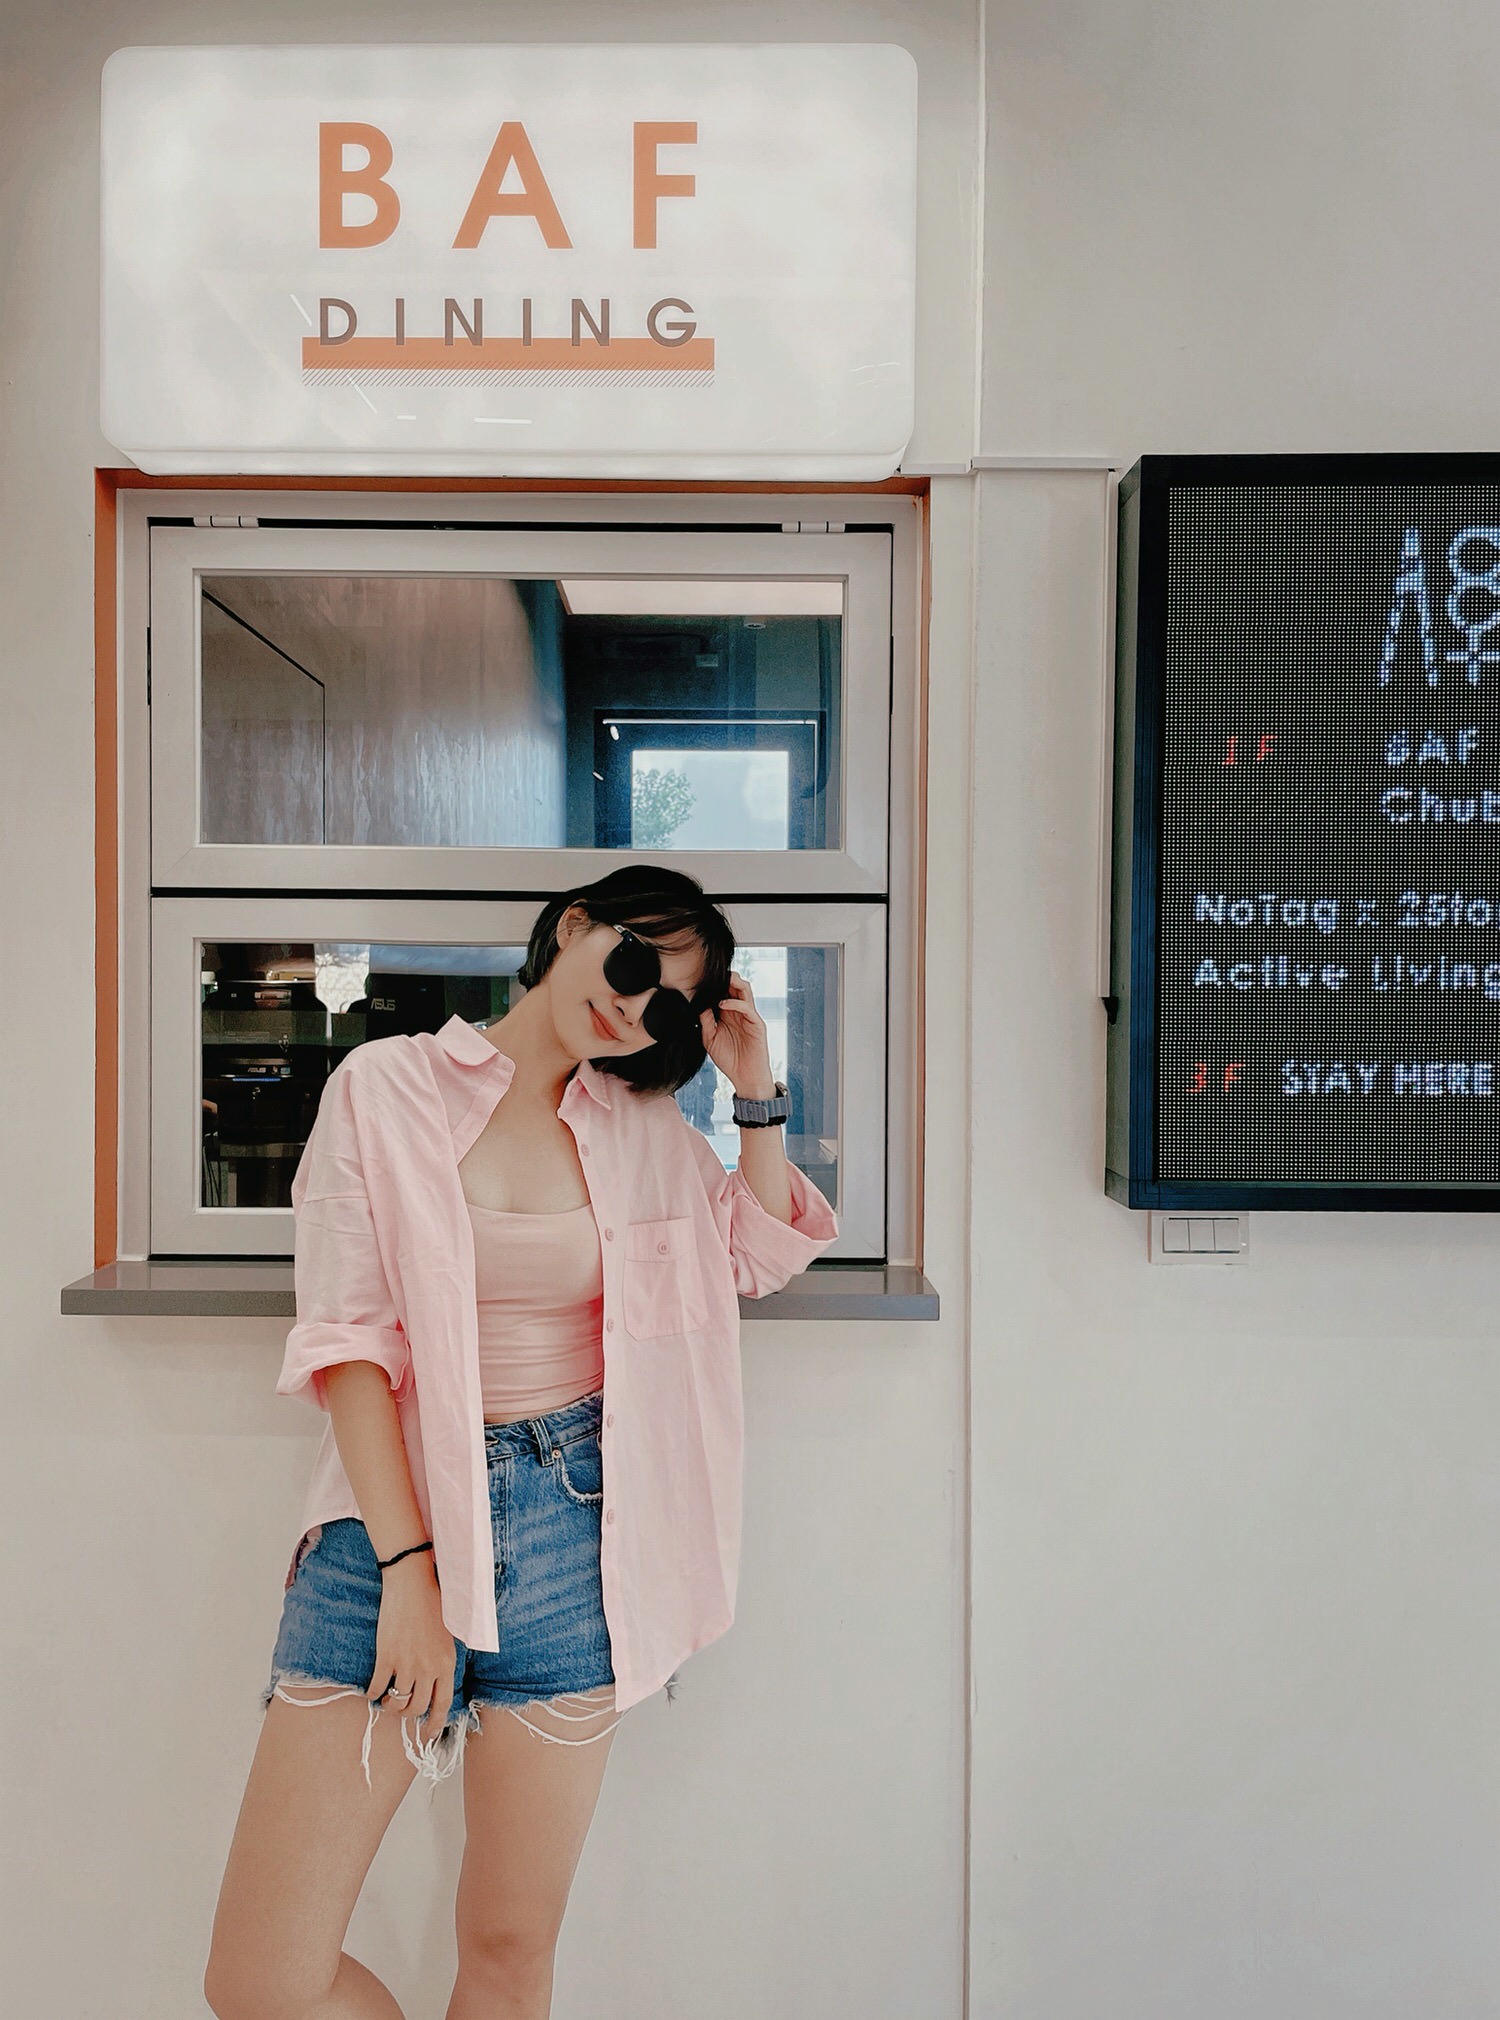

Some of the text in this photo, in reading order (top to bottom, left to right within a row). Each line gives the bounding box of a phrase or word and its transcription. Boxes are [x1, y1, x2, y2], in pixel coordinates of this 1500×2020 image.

[320, 121, 698, 250] BAF
[320, 297, 698, 347] DINING
[1195, 894, 1339, 934] NoTag
[1195, 957, 1348, 990] Active
[1281, 1059, 1380, 1095] STAY
[1394, 1063, 1495, 1096] HERE
